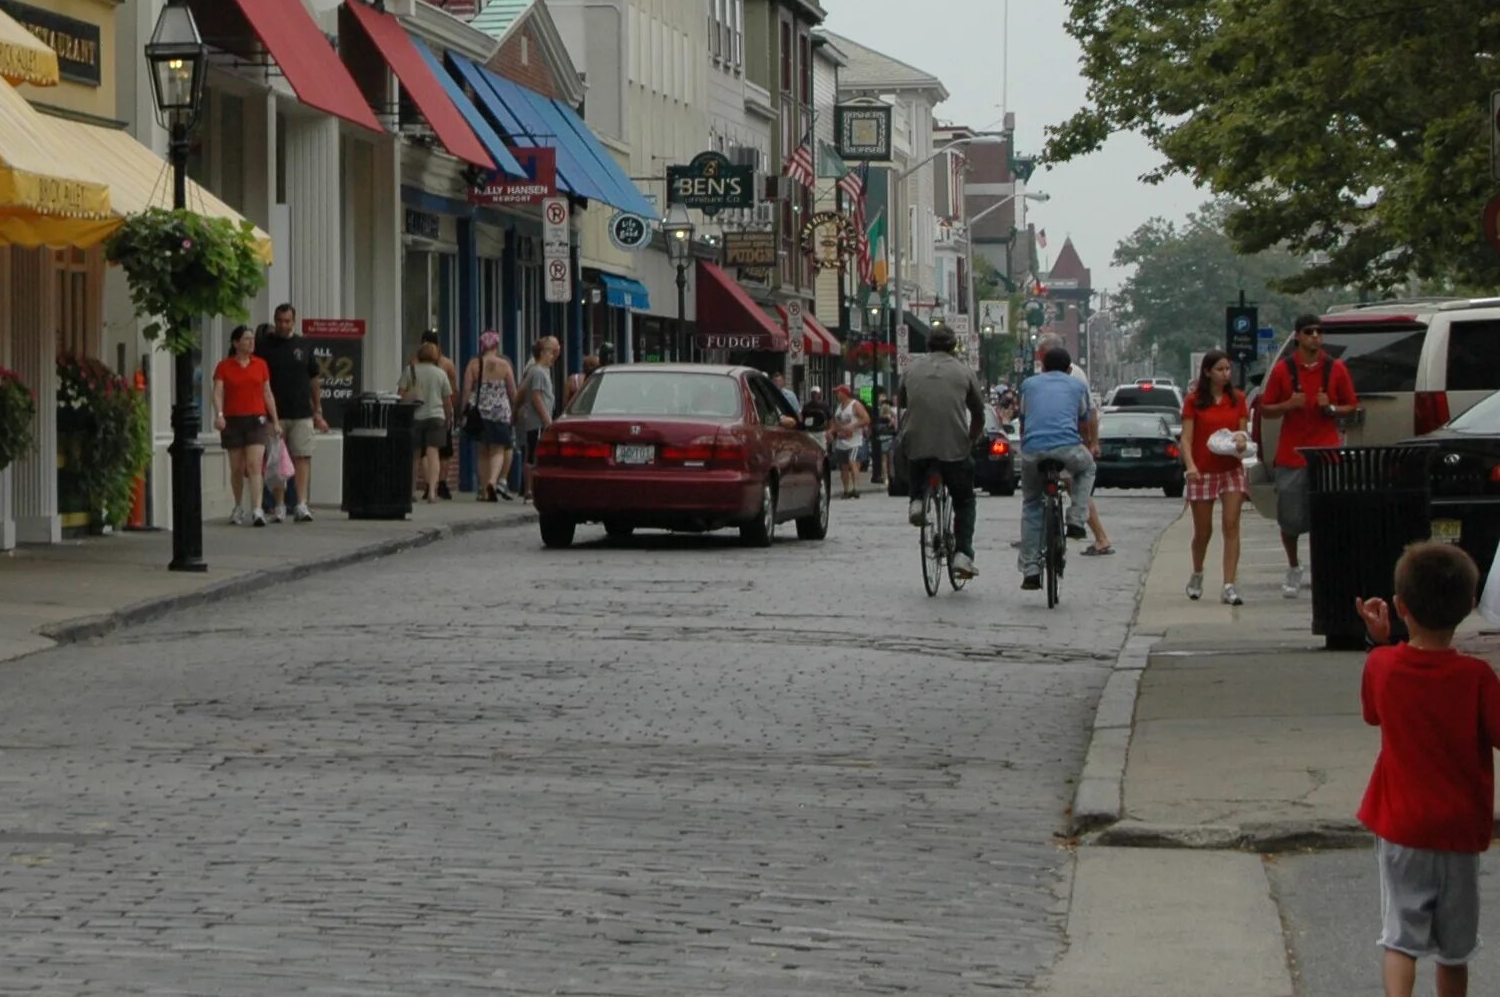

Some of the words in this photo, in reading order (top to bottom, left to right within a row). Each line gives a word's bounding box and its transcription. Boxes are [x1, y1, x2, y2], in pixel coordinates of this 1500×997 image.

[473, 185, 504, 195] HLLY
[506, 184, 549, 195] HANSEN
[678, 177, 741, 195] BEN'S
[707, 335, 761, 348] FUDGE
[313, 347, 332, 357] ALL
[333, 389, 353, 399] OFF
